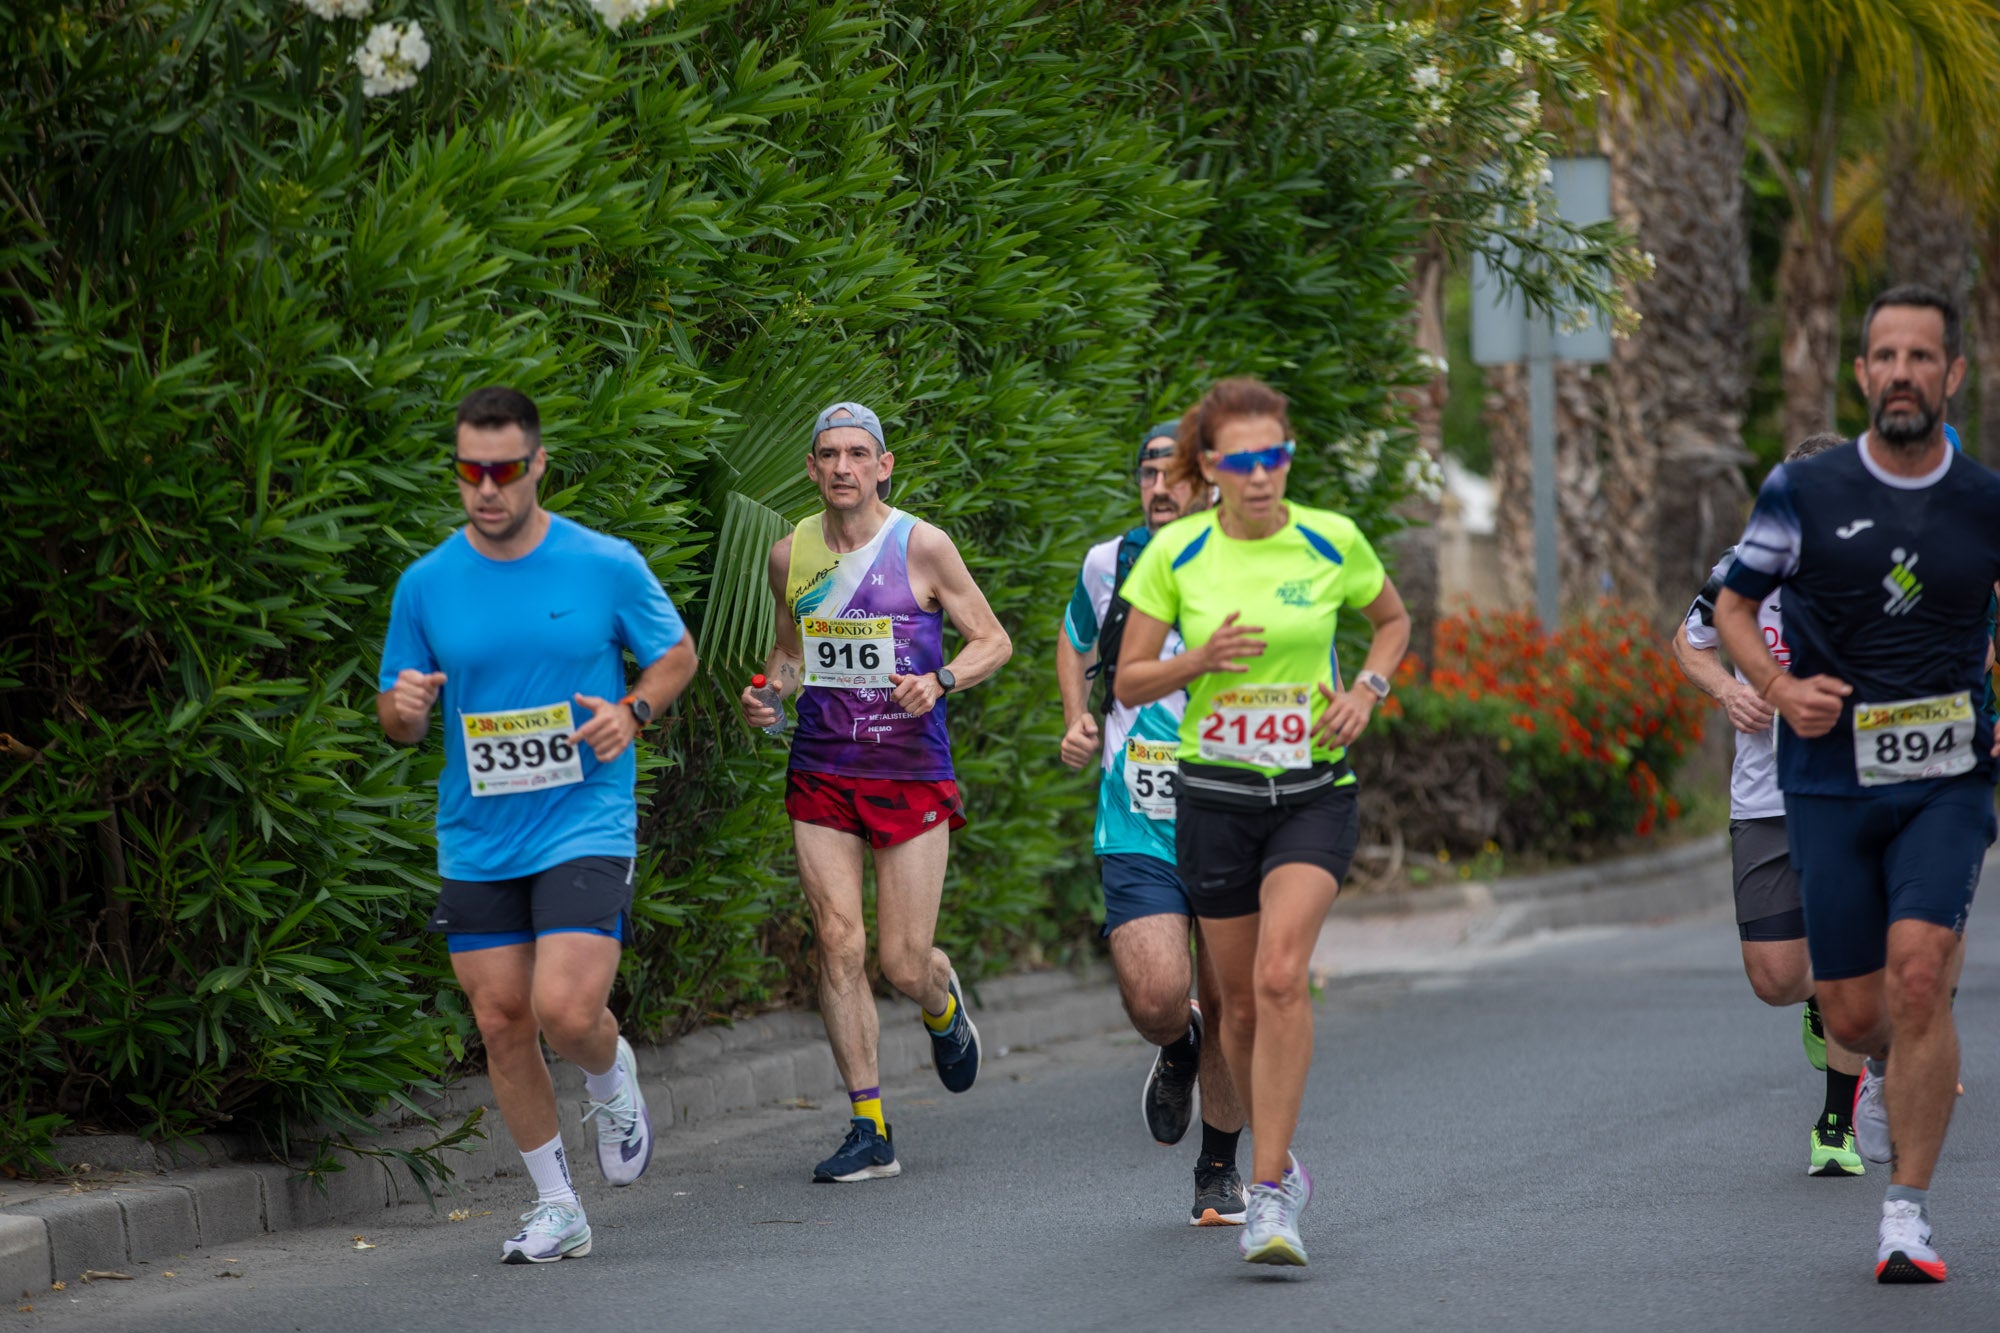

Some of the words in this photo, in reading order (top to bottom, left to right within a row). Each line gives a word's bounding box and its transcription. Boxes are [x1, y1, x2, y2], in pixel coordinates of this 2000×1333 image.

[815, 621, 828, 633] 38
[828, 626, 873, 635] FONDO
[818, 641, 880, 669] 916
[478, 718, 494, 732] 38
[1202, 712, 1306, 746] 2149
[472, 733, 574, 773] 3396
[1876, 726, 1957, 764] 894
